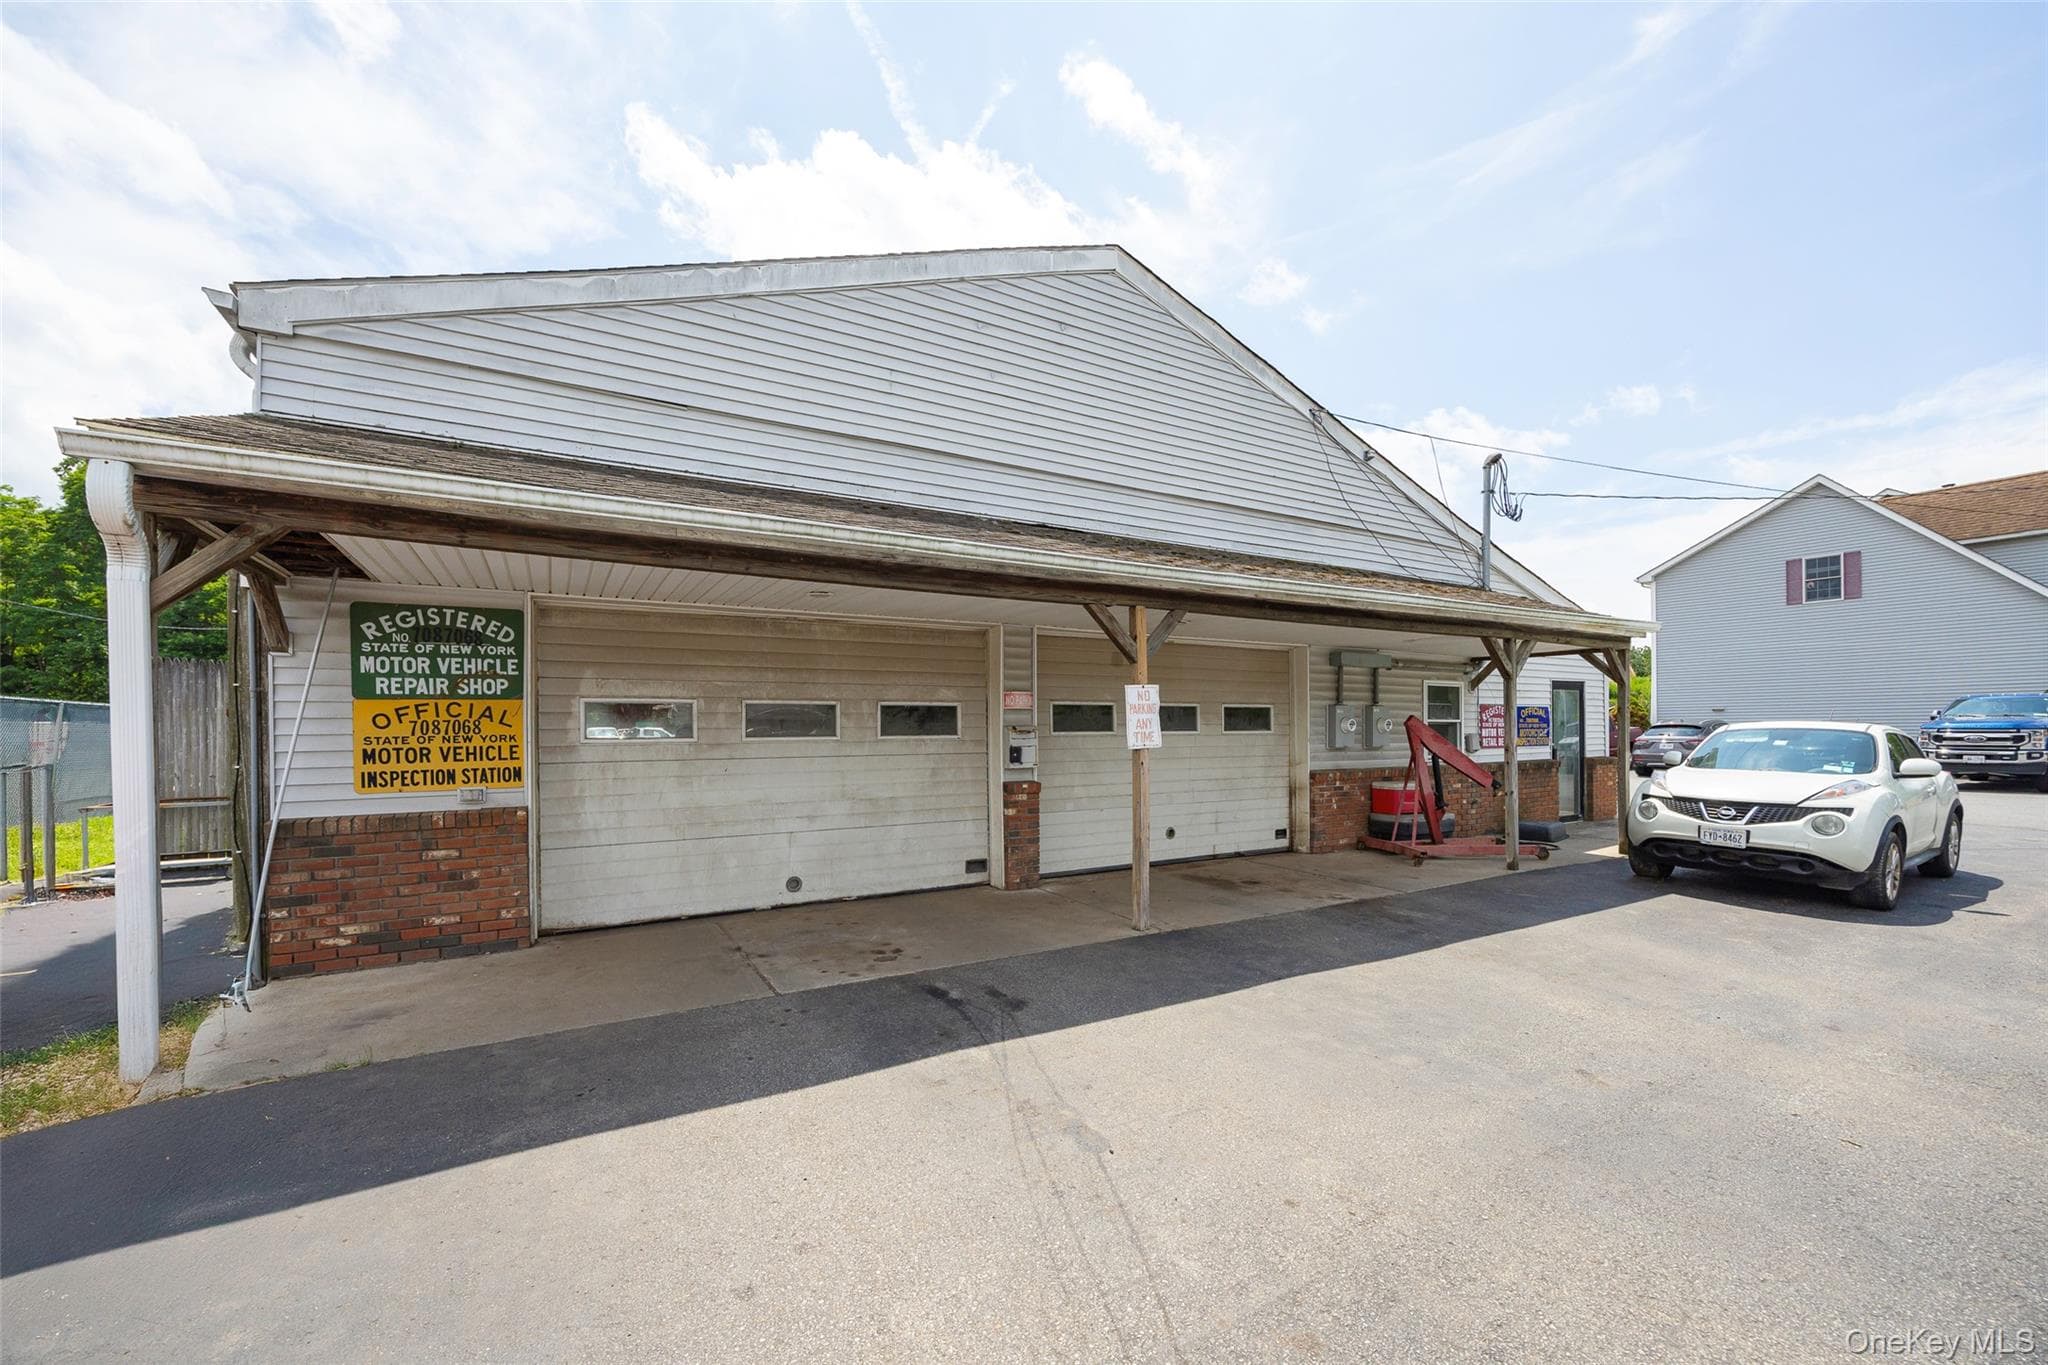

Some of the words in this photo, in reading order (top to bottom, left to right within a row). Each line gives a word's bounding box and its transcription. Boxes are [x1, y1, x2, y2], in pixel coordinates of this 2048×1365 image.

[360, 608, 515, 642] REGISTERED
[392, 632, 411, 643] NO.
[361, 642, 409, 653] STATE
[414, 644, 435, 653] OF
[440, 644, 473, 654] NEW
[477, 645, 516, 656] YORK
[360, 655, 431, 674] MOTOR
[437, 657, 519, 675] VEHICLE
[375, 677, 449, 695] REPAIR
[456, 678, 509, 695] SHOP
[1136, 690, 1150, 702] NO
[371, 701, 513, 730] OFFICIAL
[1129, 703, 1157, 714] PARKING
[1520, 708, 1546, 718] OFFICIAL
[409, 719, 482, 736] 7087068
[1136, 718, 1152, 730] ANY
[363, 736, 410, 746] STATE
[416, 735, 436, 745] OF
[442, 735, 473, 744] NEW
[480, 734, 518, 743] YORK
[1134, 731, 1155, 743] TIME
[362, 747, 431, 765] MOTOR
[439, 745, 520, 763] VEHICLE
[361, 768, 456, 789] INSPECTION
[461, 766, 522, 784] STATION
